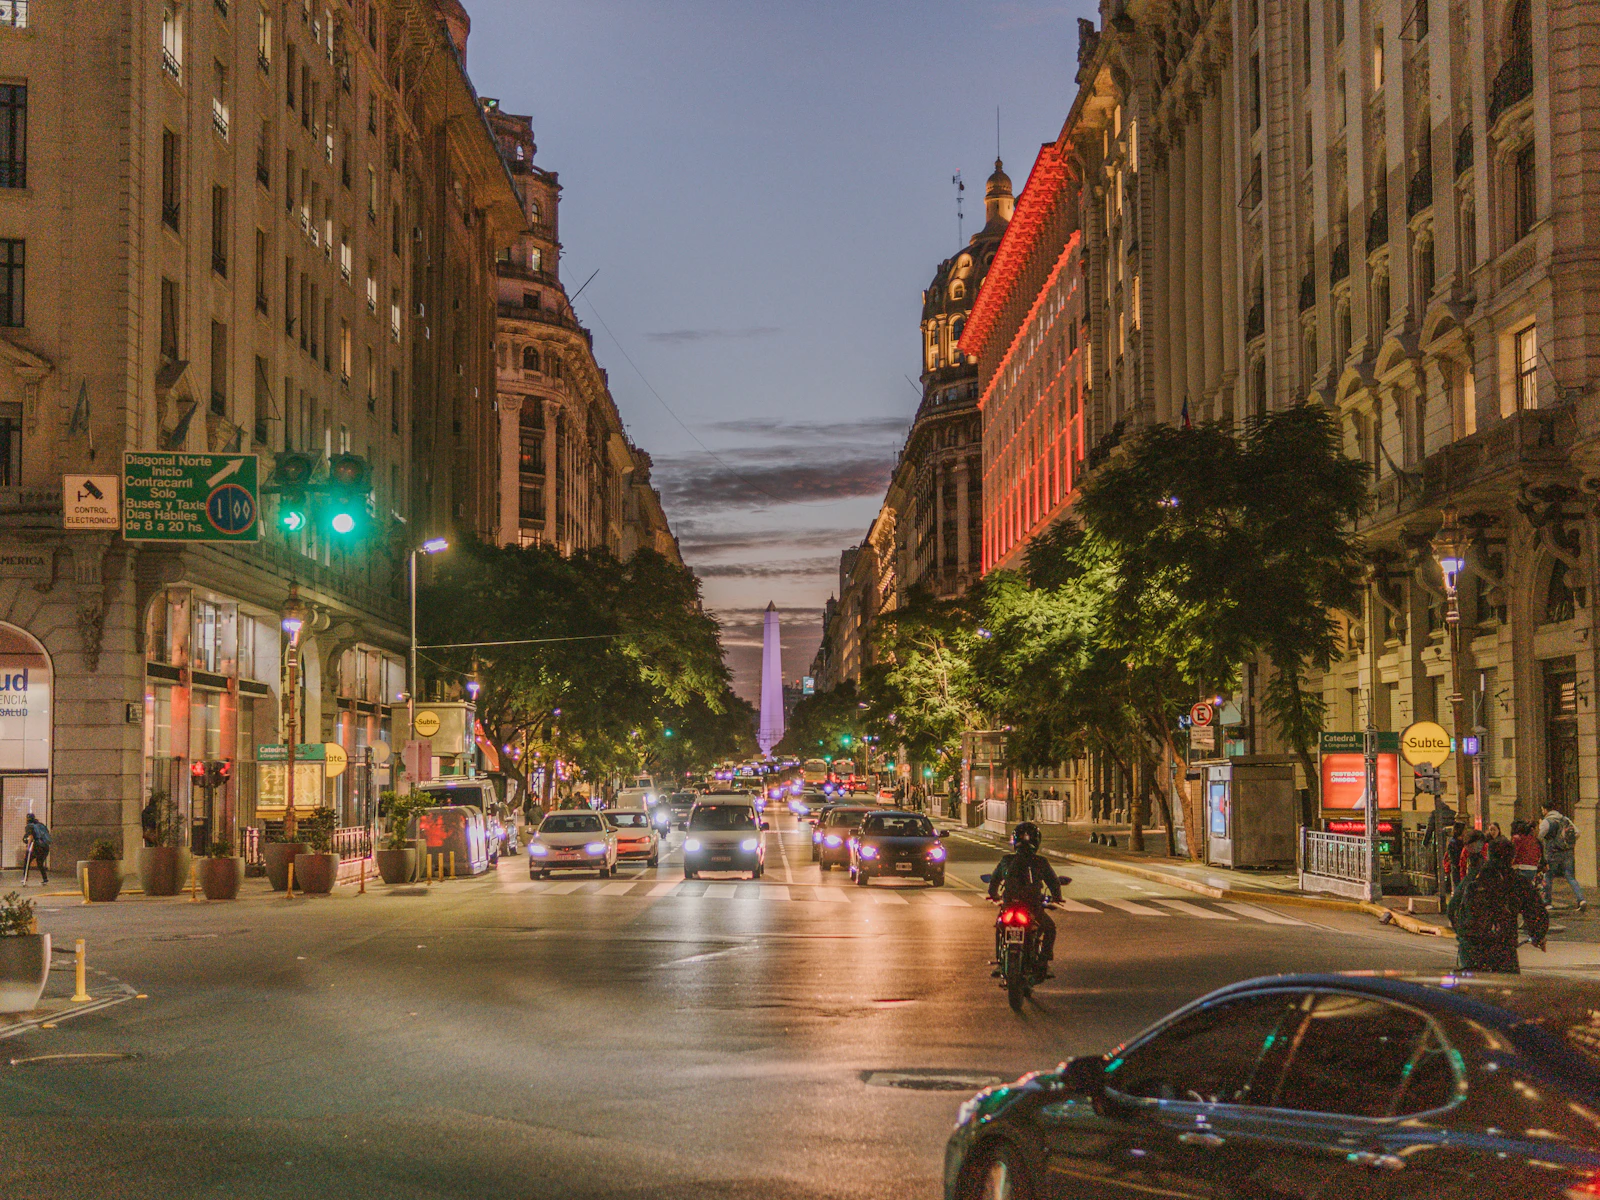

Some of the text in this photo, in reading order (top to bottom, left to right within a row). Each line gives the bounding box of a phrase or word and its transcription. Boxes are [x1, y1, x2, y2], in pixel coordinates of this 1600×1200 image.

[125, 454, 212, 467] Diagonal Norte
[152, 466, 183, 477] Inicio
[125, 475, 193, 488] Contracarril
[150, 487, 177, 498] Solo
[74, 506, 108, 514] CONTROL
[126, 498, 207, 511] Buses y Taxis
[66, 516, 117, 524] ELECTRONICO
[125, 520, 205, 532] de 8 a 20 hs.
[1324, 734, 1356, 742] Catedral
[1409, 737, 1445, 748] Subte
